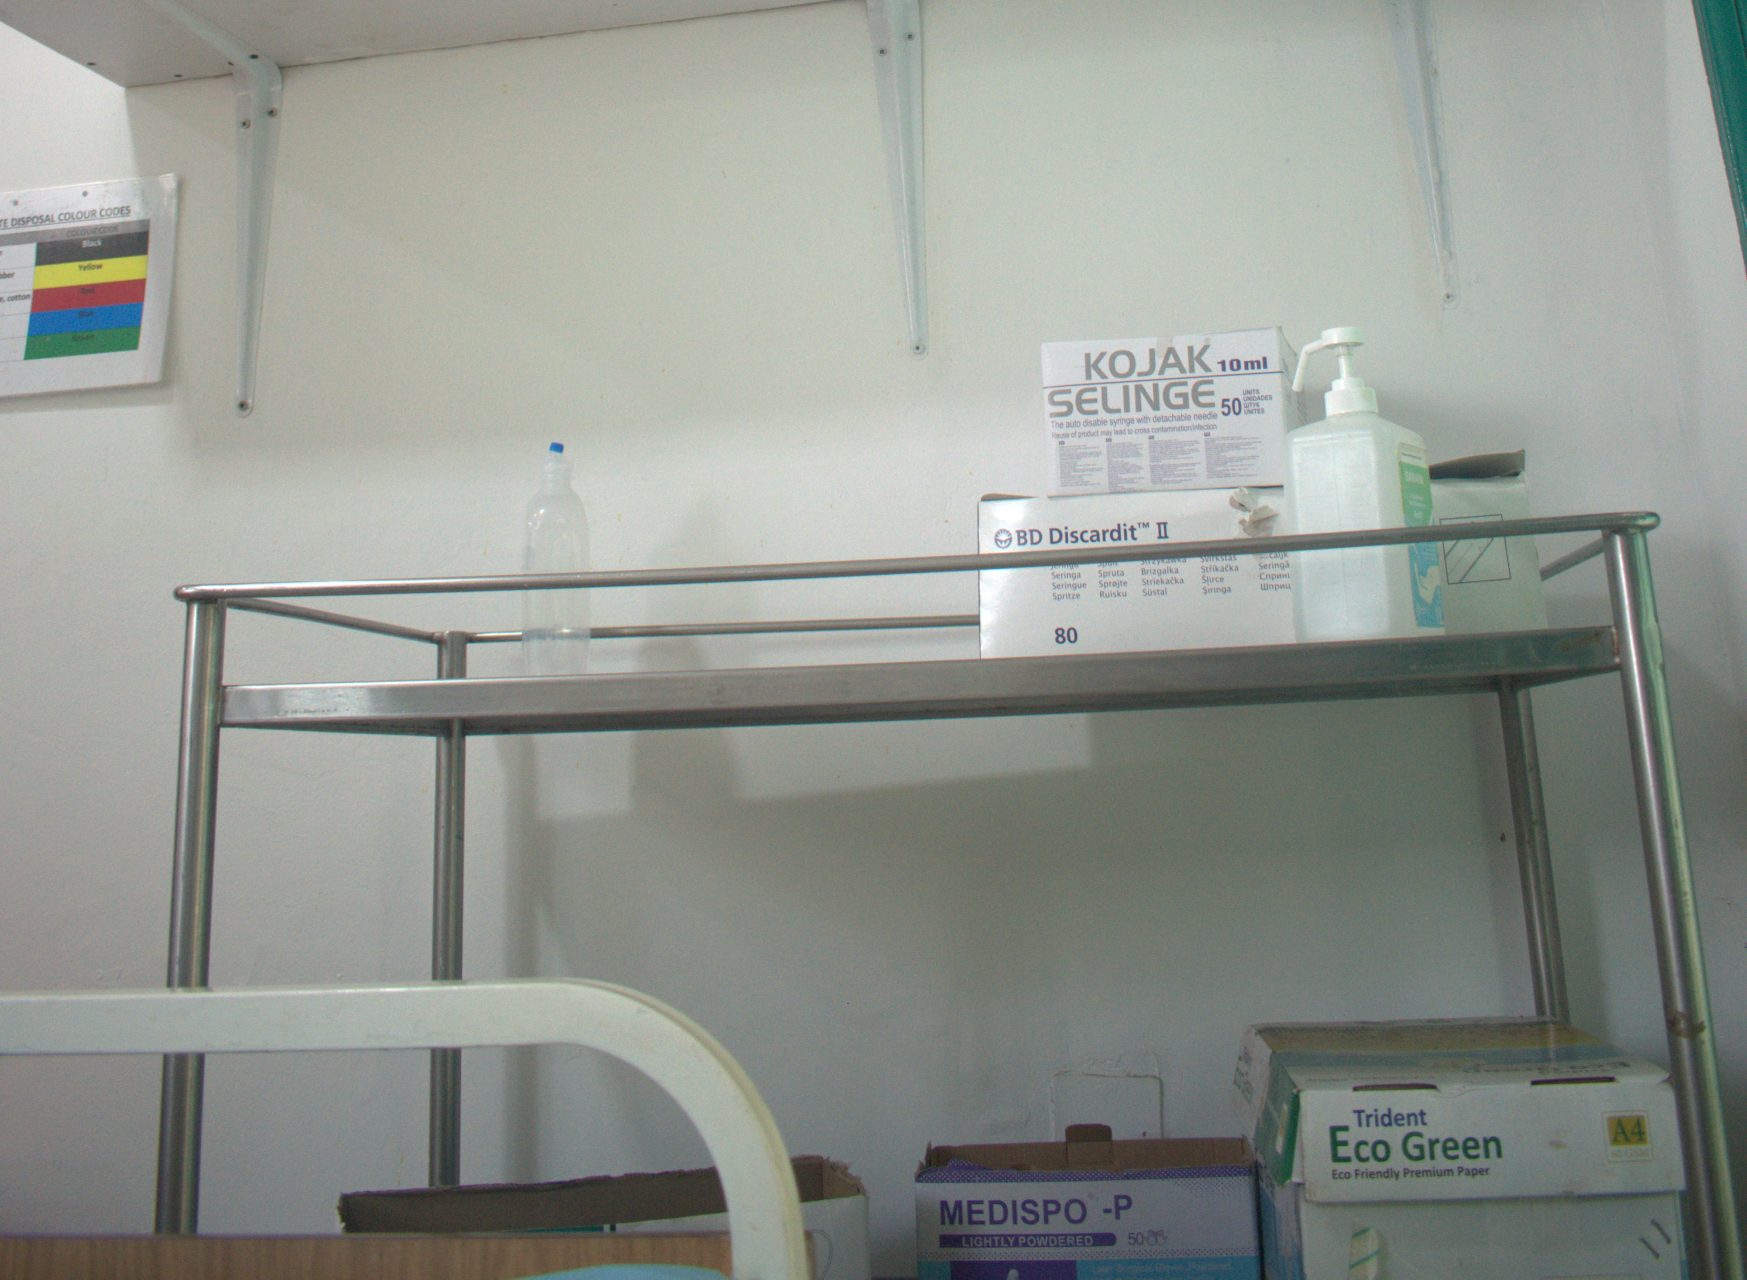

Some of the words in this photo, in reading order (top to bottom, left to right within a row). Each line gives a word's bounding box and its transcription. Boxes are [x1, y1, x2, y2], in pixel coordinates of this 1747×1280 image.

[11, 214, 56, 227] DISPOSAL
[58, 209, 97, 222] COLOUR
[99, 205, 131, 217] CODES
[82, 239, 102, 248] Black
[79, 263, 103, 272] Yellow
[1084, 344, 1212, 381] KOJAK
[1217, 356, 1268, 372] 10ml
[1048, 379, 1216, 418] SELINGE
[1221, 397, 1242, 416] 50
[1051, 420, 1064, 429] The
[1065, 419, 1080, 429] auto
[1082, 417, 1108, 428] disable
[1109, 417, 1135, 428] syringe
[1136, 415, 1151, 424] with
[1152, 413, 1191, 424] detachable
[1193, 412, 1218, 421] needle
[1071, 430, 1077, 438] of
[1078, 429, 1099, 439] product
[1100, 428, 1112, 437] may
[1127, 427, 1133, 435] to
[1134, 426, 1150, 434] cross
[1016, 529, 1043, 547] BD
[1156, 521, 1169, 539] II
[1051, 571, 1081, 580] Seringa
[1098, 569, 1125, 578] Spruta
[1141, 567, 1179, 577] Brizgalka
[1051, 581, 1087, 591] Seringue
[1098, 579, 1128, 589] Sprøjte
[1052, 591, 1081, 601] Spritze
[1099, 590, 1127, 599] Ruisku
[1054, 627, 1078, 645] 80
[1352, 1107, 1428, 1128] Trident
[1612, 1117, 1646, 1142] A4
[1329, 1125, 1391, 1163] Eco
[1401, 1131, 1503, 1162] Green
[1332, 1169, 1351, 1180] Eco
[1355, 1167, 1400, 1181] Friendly
[1403, 1166, 1454, 1178] Premium
[1458, 1166, 1490, 1178] Paper
[962, 1236, 1015, 1248] LIGHTLY
[1018, 1234, 1094, 1247] POWDERED
[1128, 1232, 1145, 1246] 50
